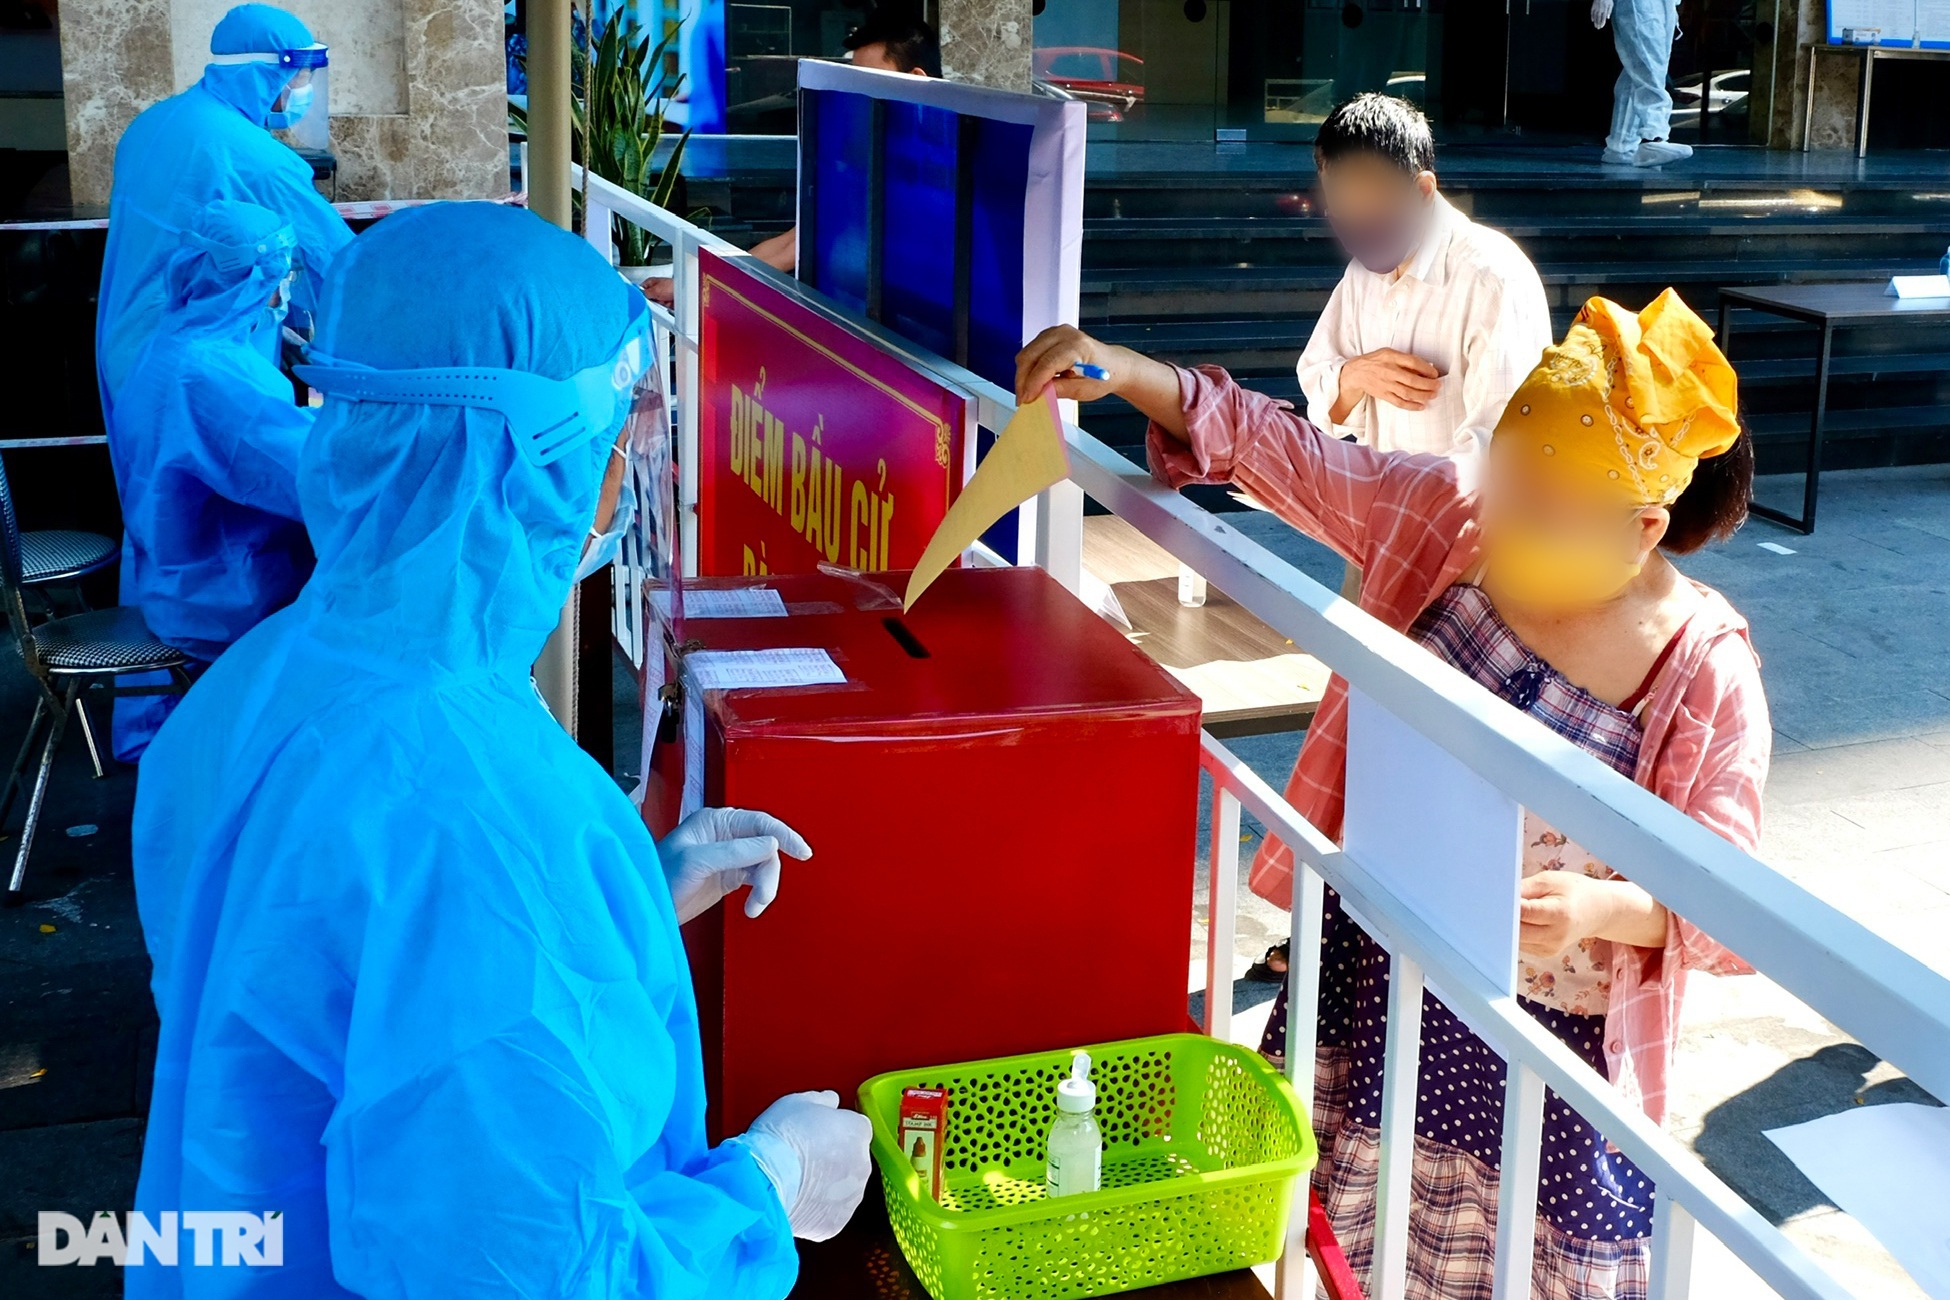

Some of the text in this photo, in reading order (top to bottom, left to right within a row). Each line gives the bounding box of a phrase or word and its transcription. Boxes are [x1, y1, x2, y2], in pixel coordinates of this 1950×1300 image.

[730, 366, 895, 572] ĐIỂM BẦU CỬ
